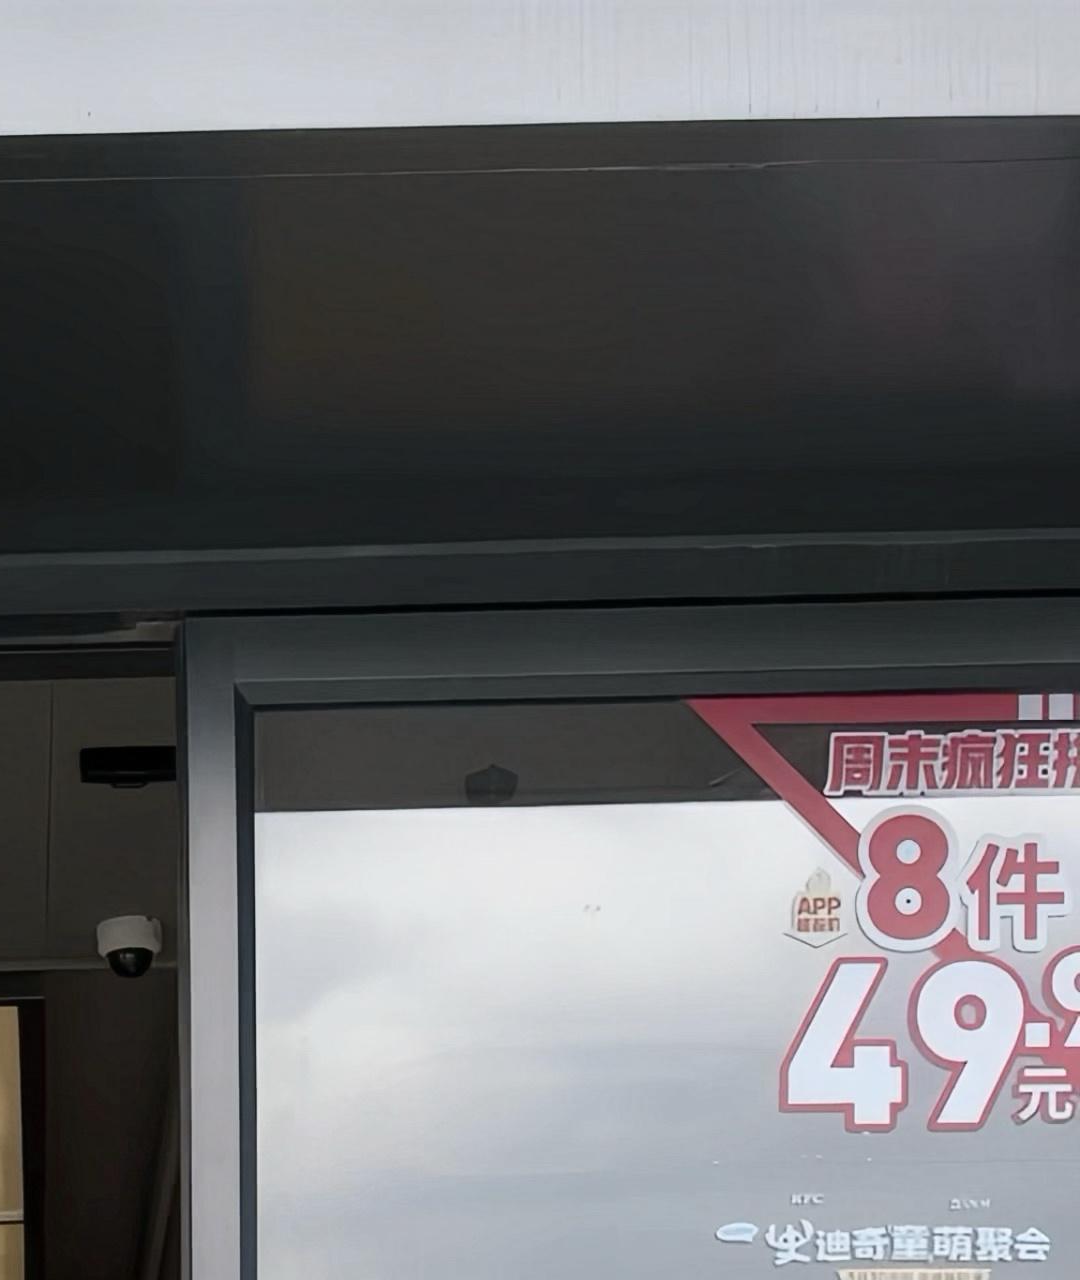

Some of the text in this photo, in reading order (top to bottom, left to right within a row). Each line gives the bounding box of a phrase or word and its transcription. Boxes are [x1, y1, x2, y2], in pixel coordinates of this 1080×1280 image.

[798, 896, 841, 915] APP
[857, 806, 1070, 952] 8件
[1012, 1066, 1077, 1124] 元
